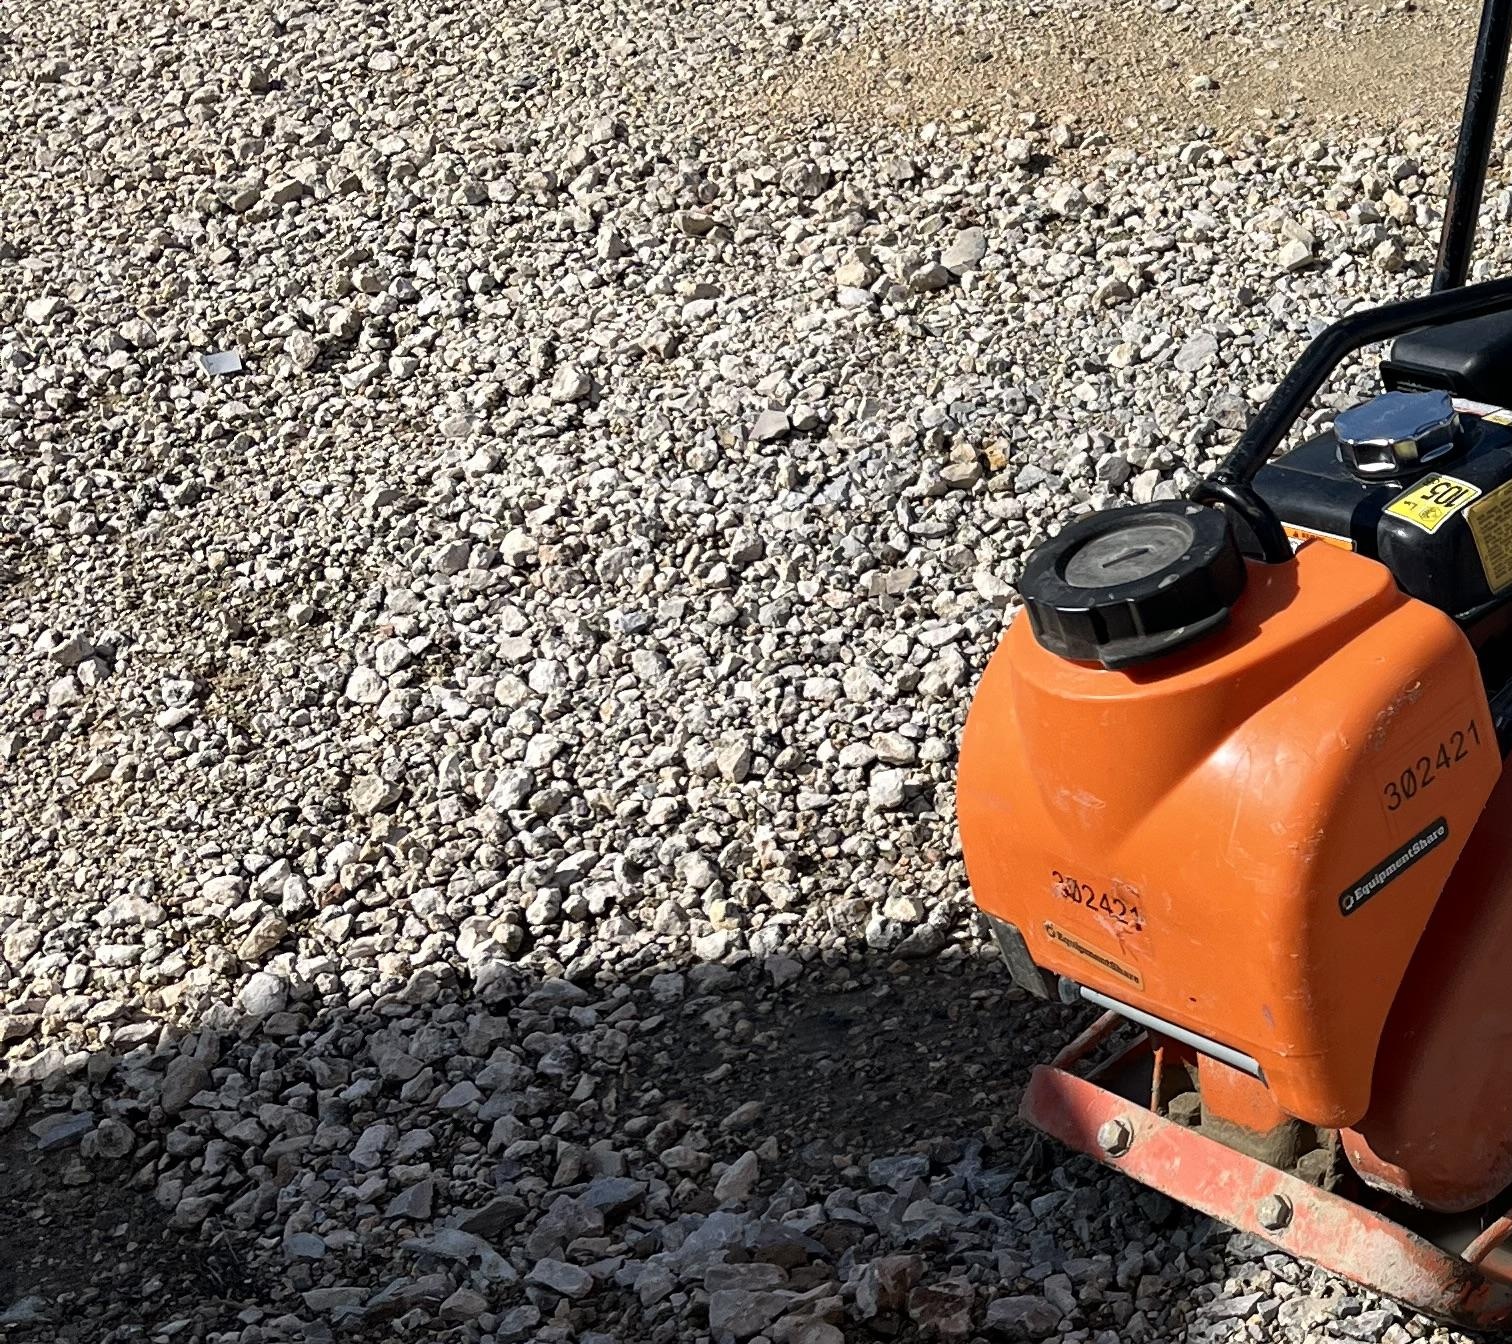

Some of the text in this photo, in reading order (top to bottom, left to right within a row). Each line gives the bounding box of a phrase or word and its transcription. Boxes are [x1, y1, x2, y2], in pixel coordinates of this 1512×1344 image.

[1420, 481, 1469, 508] 105
[1384, 719, 1481, 811] 302421
[1353, 825, 1445, 902] EquipmentShare
